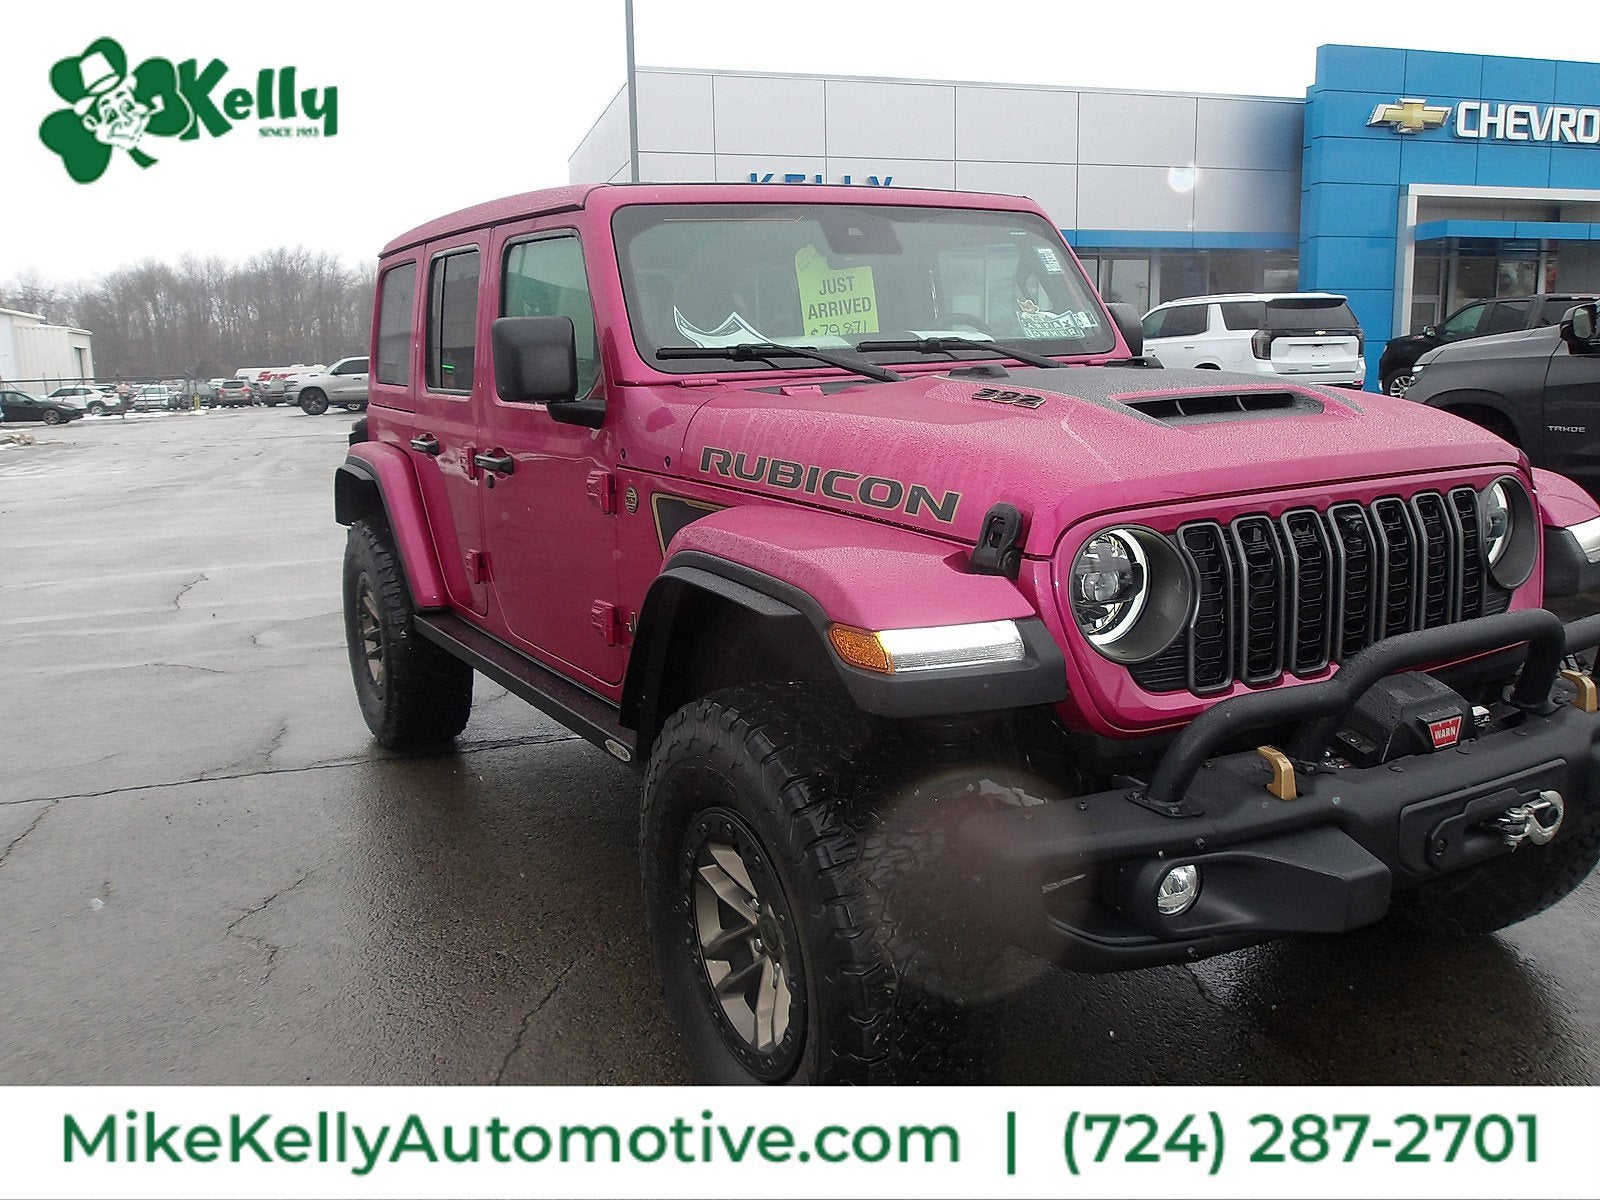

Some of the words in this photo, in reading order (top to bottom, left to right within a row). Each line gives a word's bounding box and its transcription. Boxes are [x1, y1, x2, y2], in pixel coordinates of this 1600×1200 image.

[819, 276, 855, 296] JUST
[808, 296, 872, 320] ARRIVED
[971, 388, 1047, 409] 392
[1547, 425, 1586, 433] TAHOE
[699, 445, 962, 524] RUBICON
[1434, 725, 1456, 740] WARN
